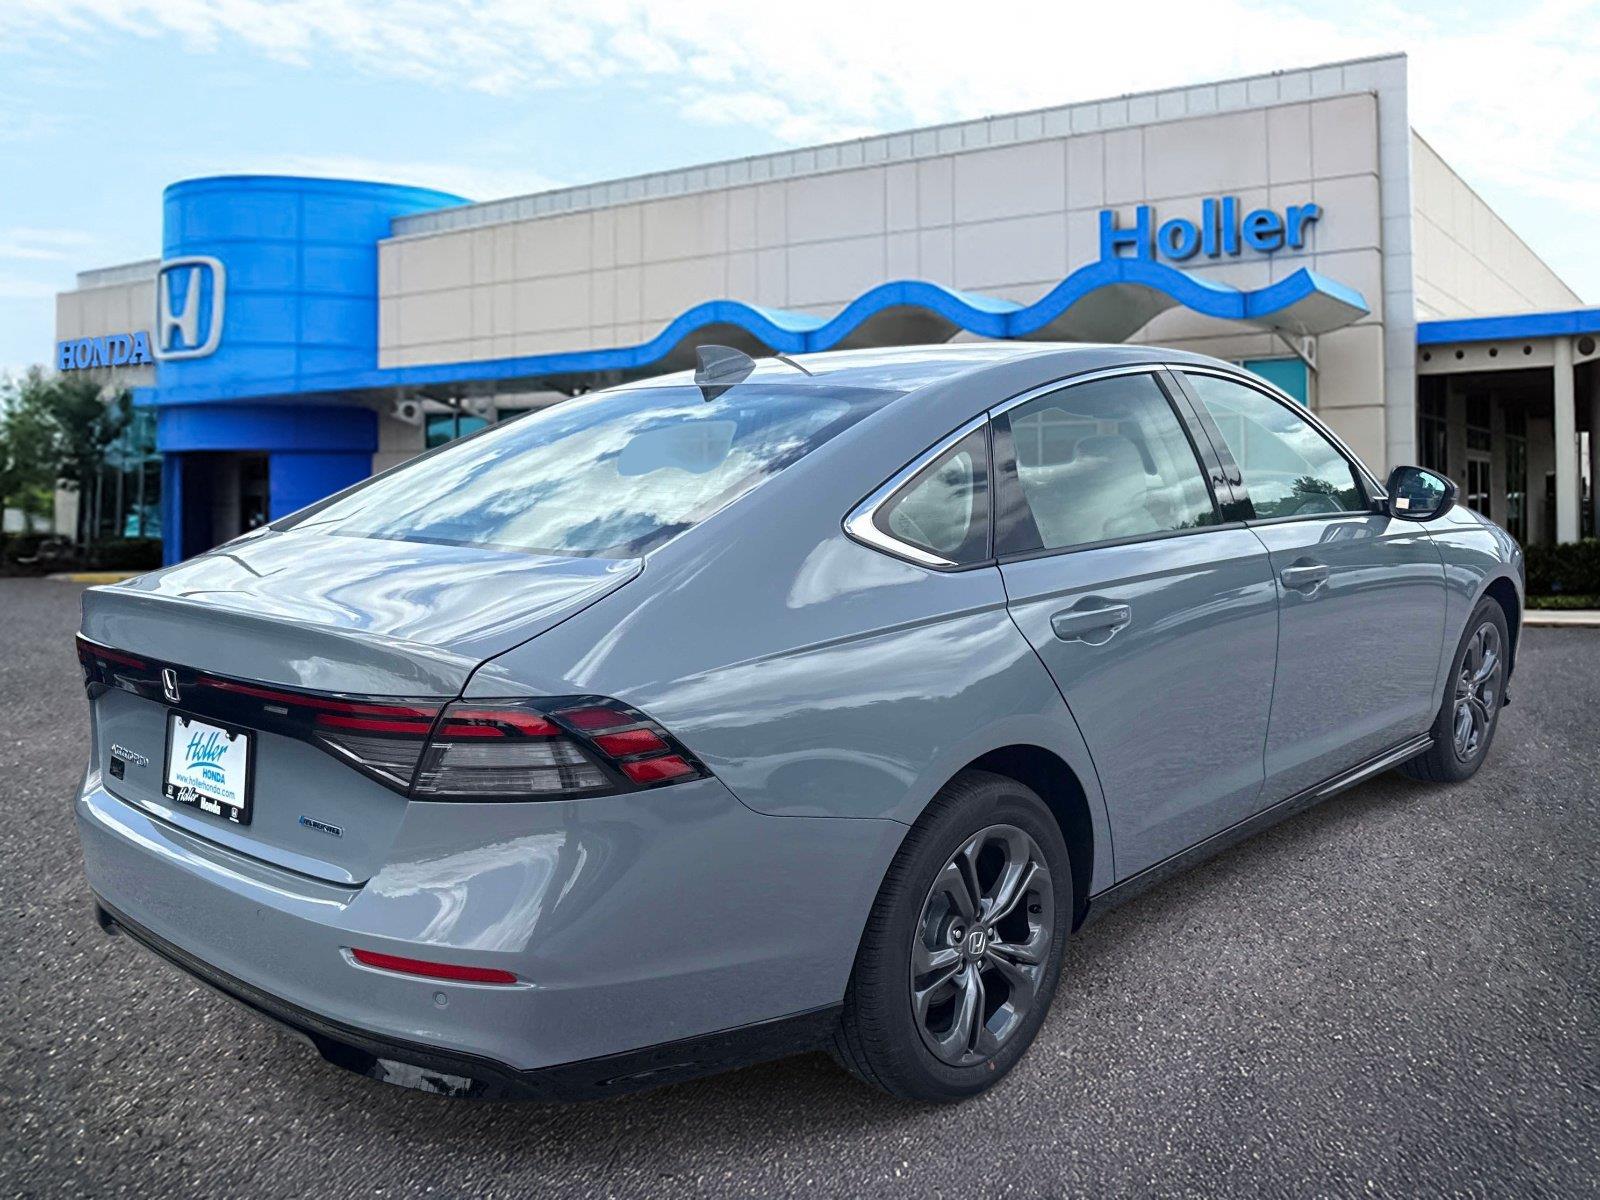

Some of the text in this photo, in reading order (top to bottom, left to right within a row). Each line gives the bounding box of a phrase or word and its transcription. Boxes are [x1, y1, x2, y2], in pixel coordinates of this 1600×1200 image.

[1099, 196, 1321, 262] Holler
[58, 331, 153, 371] HONDA
[185, 731, 229, 762] Holler
[202, 768, 226, 785] HONDA
[176, 787, 199, 802] Holler
[200, 796, 221, 815] Honda
